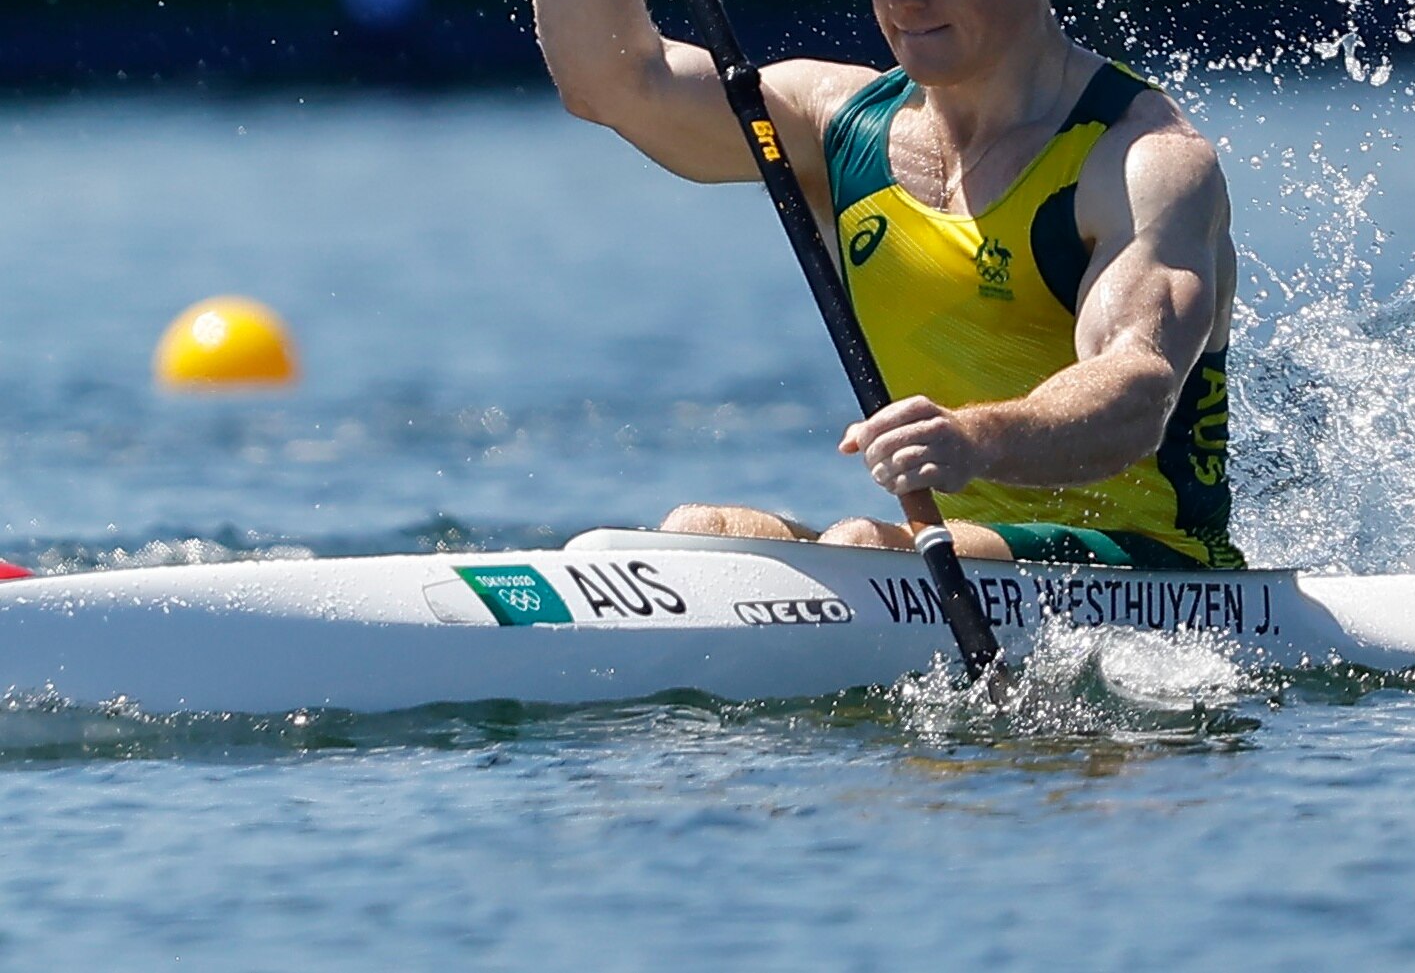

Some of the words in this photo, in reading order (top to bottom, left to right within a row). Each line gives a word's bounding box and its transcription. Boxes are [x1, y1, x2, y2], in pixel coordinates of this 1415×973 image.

[1190, 367, 1227, 486] AUS
[565, 560, 687, 618] AUS
[737, 600, 850, 624] NELO
[868, 578, 950, 625] VAN
[1033, 578, 1244, 634] WESTHUYZEN
[1254, 584, 1281, 636] J.
